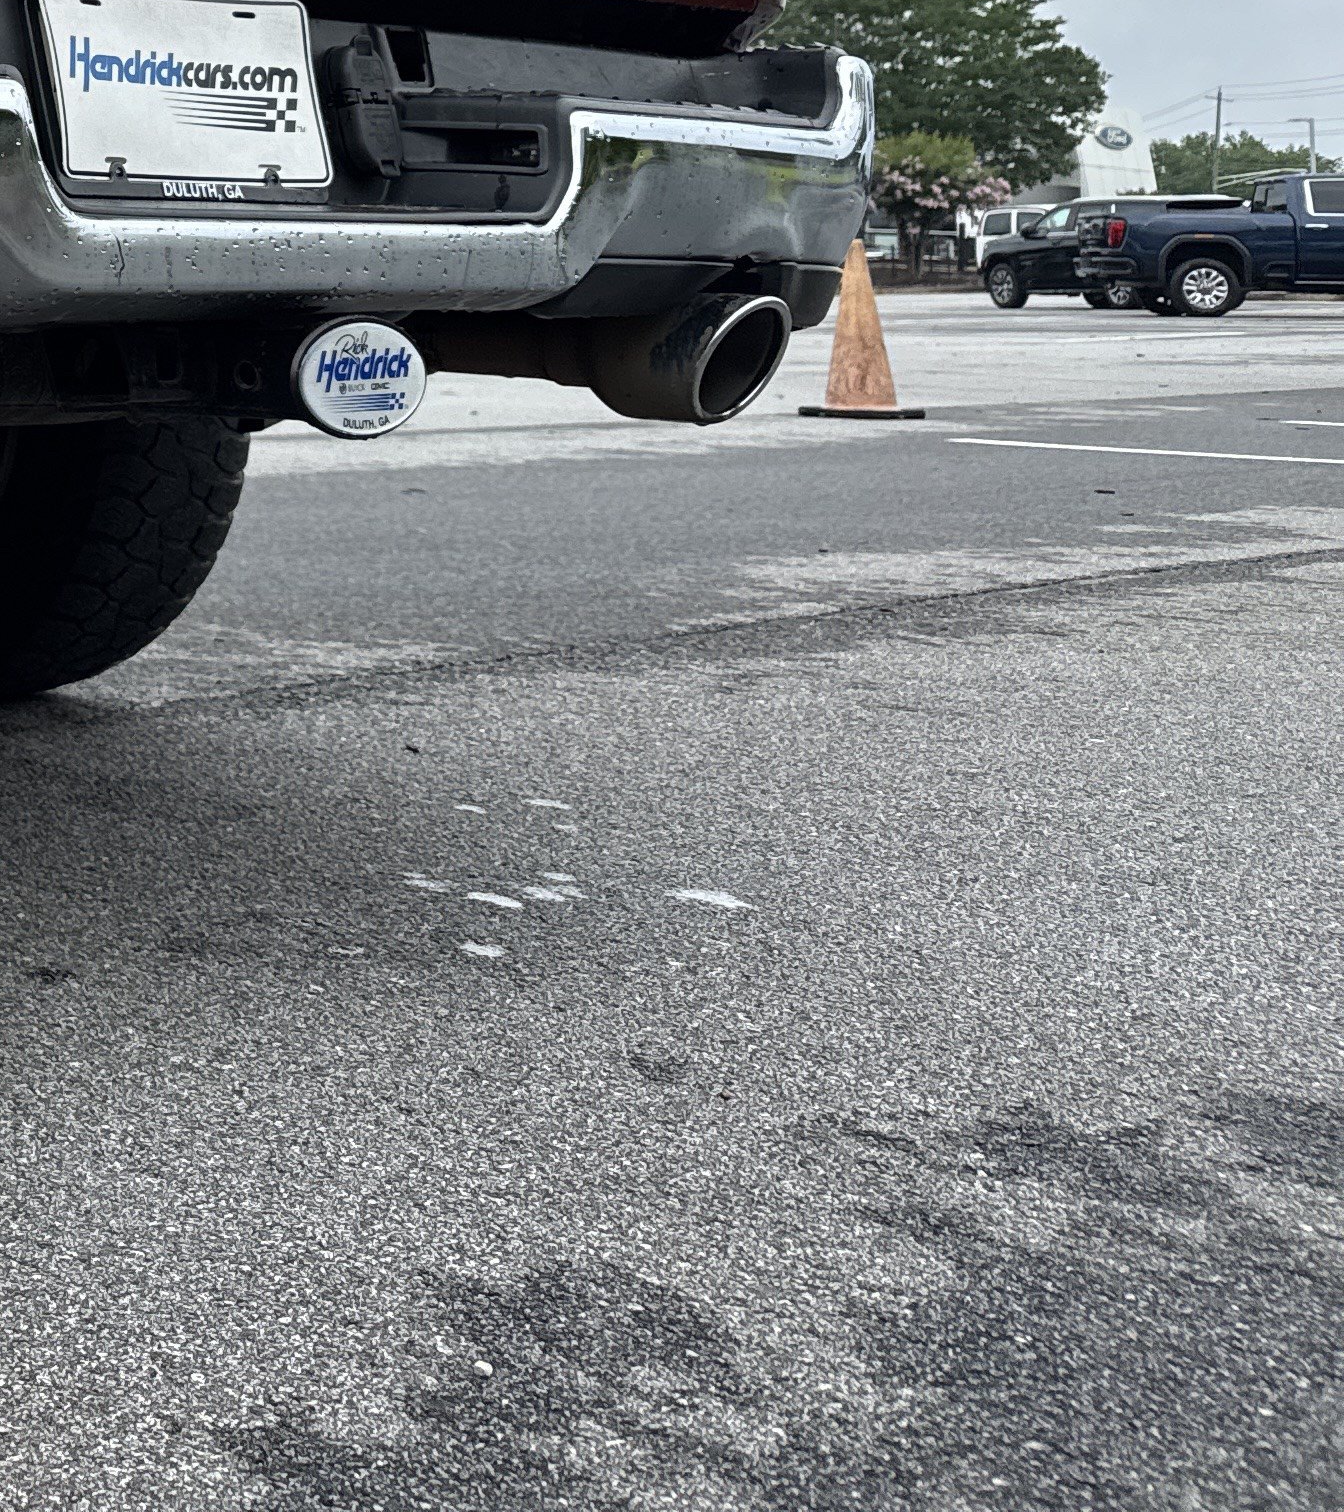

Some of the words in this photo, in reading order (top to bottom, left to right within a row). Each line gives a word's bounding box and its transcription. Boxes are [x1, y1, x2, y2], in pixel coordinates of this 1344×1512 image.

[69, 35, 298, 93] Hendrickcars.com
[1107, 128, 1128, 145] Ford
[162, 181, 223, 202] DULUTH,
[223, 184, 245, 199] GA
[315, 347, 412, 393] Hendrick
[342, 417, 377, 430] DULUTH,
[378, 415, 391, 427] GA
